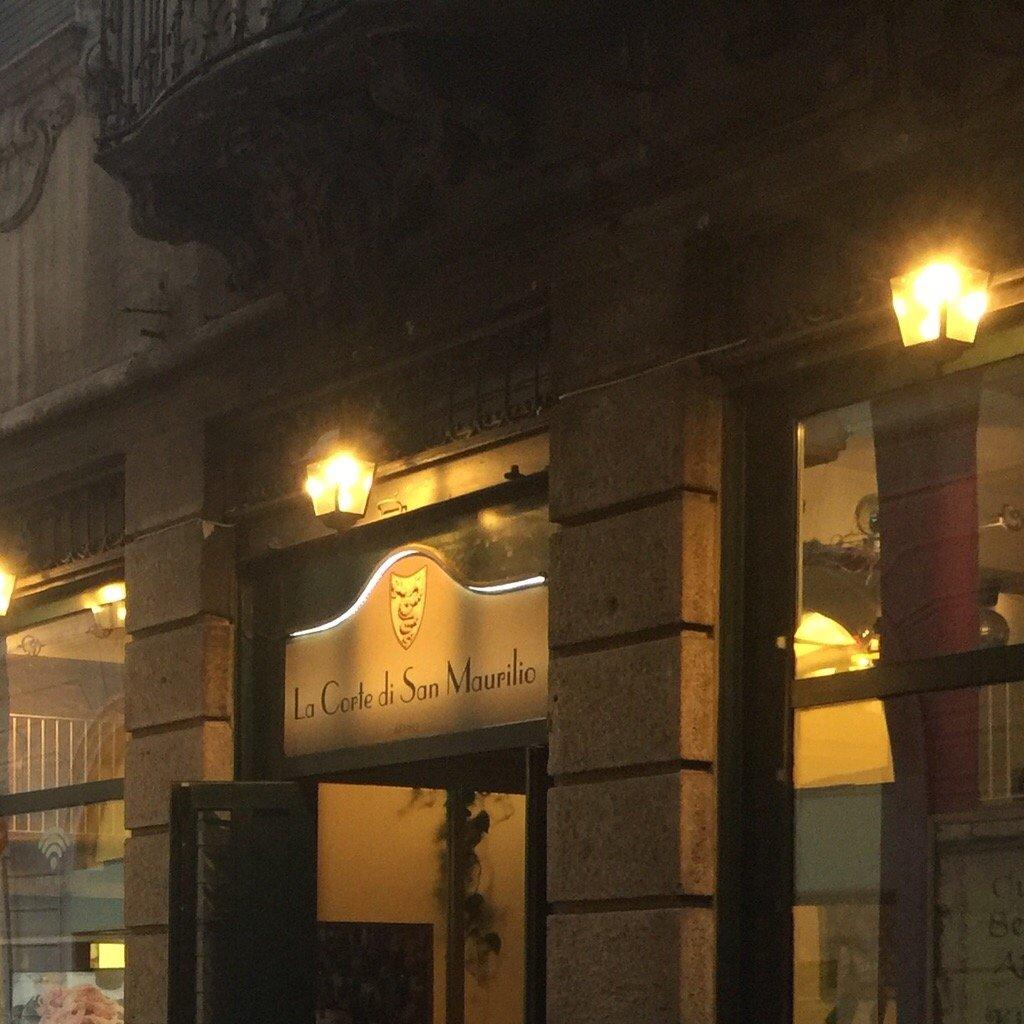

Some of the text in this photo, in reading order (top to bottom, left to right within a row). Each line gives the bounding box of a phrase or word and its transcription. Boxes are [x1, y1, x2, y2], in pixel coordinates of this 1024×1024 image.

[294, 649, 536, 720] La Corte di San Maurilio
